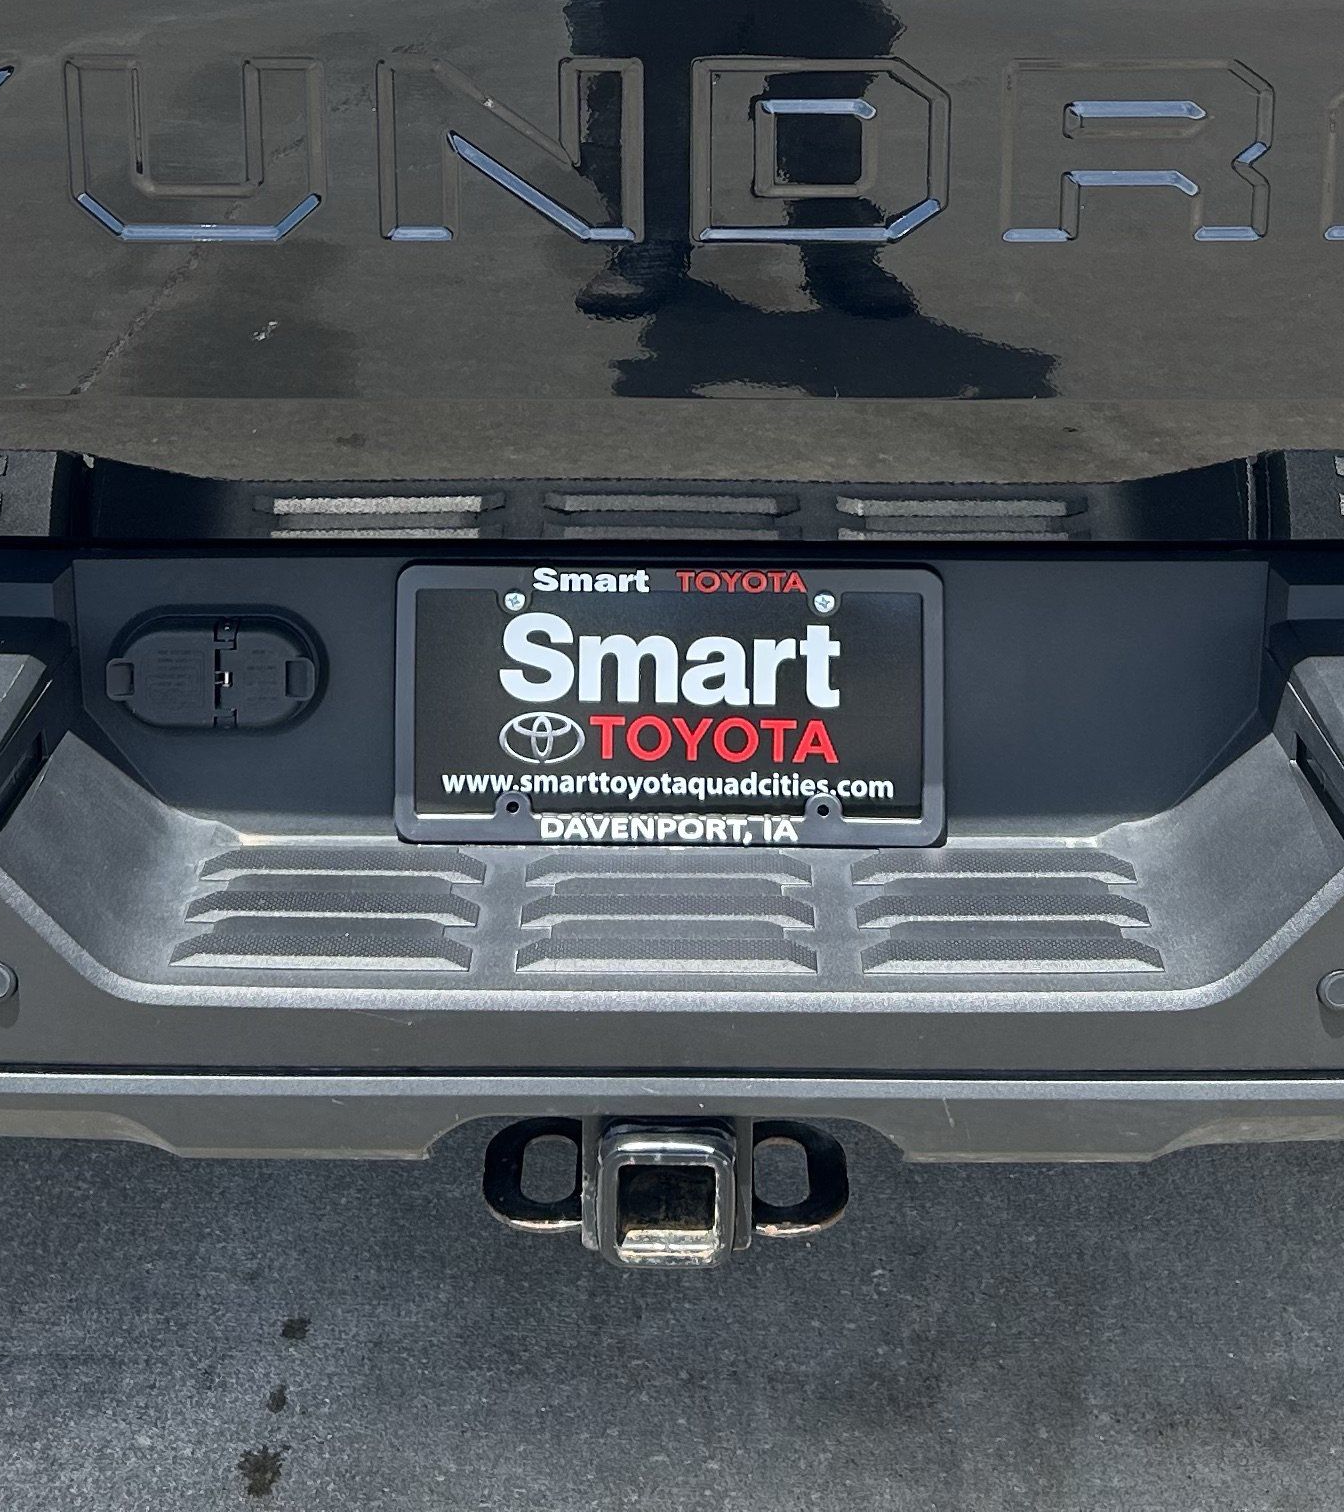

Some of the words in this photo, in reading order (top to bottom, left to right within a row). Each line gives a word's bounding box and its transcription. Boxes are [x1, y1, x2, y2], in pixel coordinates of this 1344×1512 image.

[533, 567, 651, 593] Smart
[674, 570, 808, 594] TOYOTA
[499, 611, 840, 708] Smart
[589, 715, 839, 764] TOYOTA
[441, 771, 894, 800] www.smarttoyotaquadcities.com
[540, 816, 753, 846] DAVENPORT,
[763, 817, 799, 841] IA
